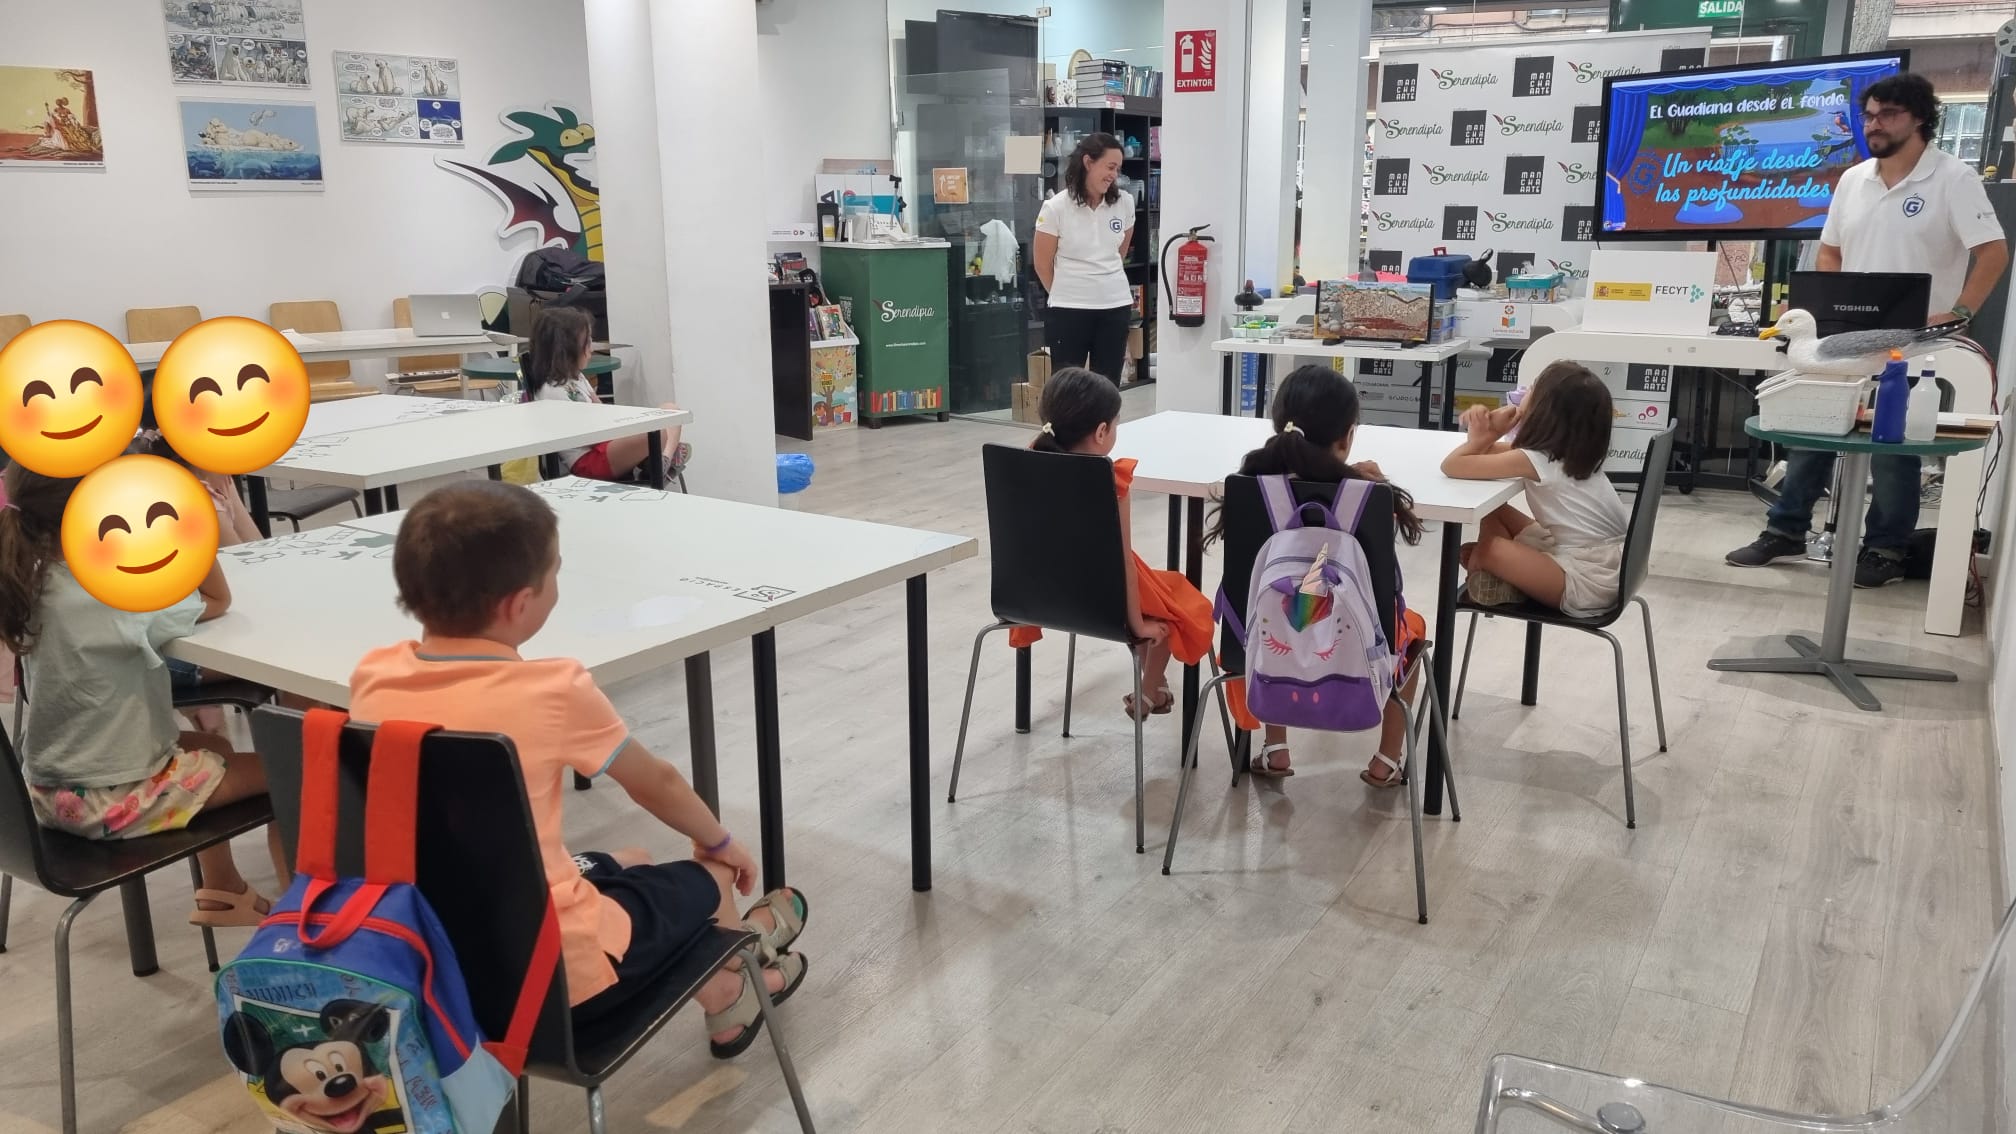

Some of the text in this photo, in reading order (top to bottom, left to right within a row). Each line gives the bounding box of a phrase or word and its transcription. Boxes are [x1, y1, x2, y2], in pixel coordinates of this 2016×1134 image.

[1700, 1, 1744, 14] SALIDA
[1176, 78, 1213, 88] EXTINTOR
[1439, 69, 1499, 90] Serendipia
[1668, 101, 1733, 118] Guadiana
[1737, 98, 1777, 114] desde
[1800, 92, 1845, 109] fondo
[1386, 119, 1443, 139] Serendipia
[1500, 115, 1564, 136] Serendipia
[1663, 153, 1693, 178] Un
[1762, 146, 1824, 170] desde
[1430, 165, 1490, 186] Serendipia
[1656, 176, 1831, 212] las profundidades
[1378, 212, 1435, 232] Serendipia
[1492, 212, 1554, 233] Serendipia
[1655, 285, 1688, 296] FECYT
[881, 300, 934, 322] Serendipia
[1833, 304, 1880, 313] TOSHIBA
